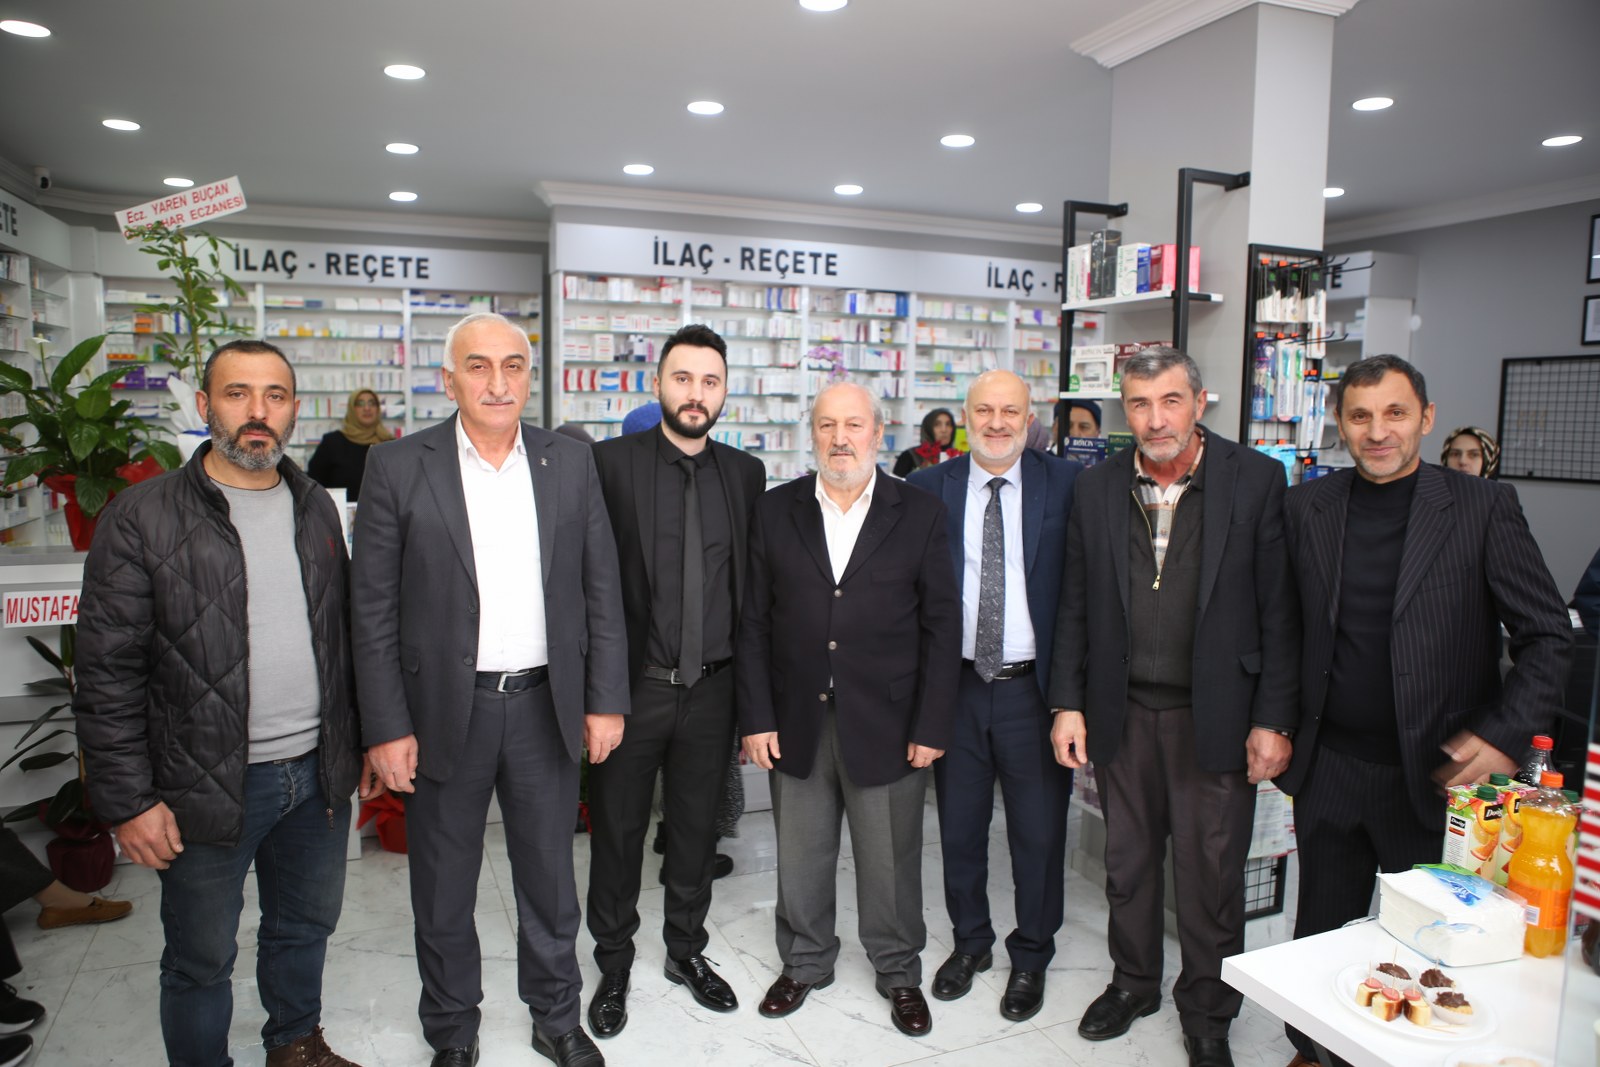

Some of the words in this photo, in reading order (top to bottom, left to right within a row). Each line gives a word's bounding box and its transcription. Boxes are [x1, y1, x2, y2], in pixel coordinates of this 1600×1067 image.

[126, 210, 148, 224] Ecz.
[151, 195, 187, 215] YAREN
[191, 182, 229, 203] BUÇAN
[189, 192, 245, 220] ECZANESİ
[234, 243, 298, 280] İLAÇ
[325, 252, 430, 283] REÇETE
[653, 235, 713, 275] İLAÇ
[740, 246, 838, 280] REÇETE
[987, 261, 1035, 296] İLAÇ
[6, 595, 79, 624] MUSTAFA
